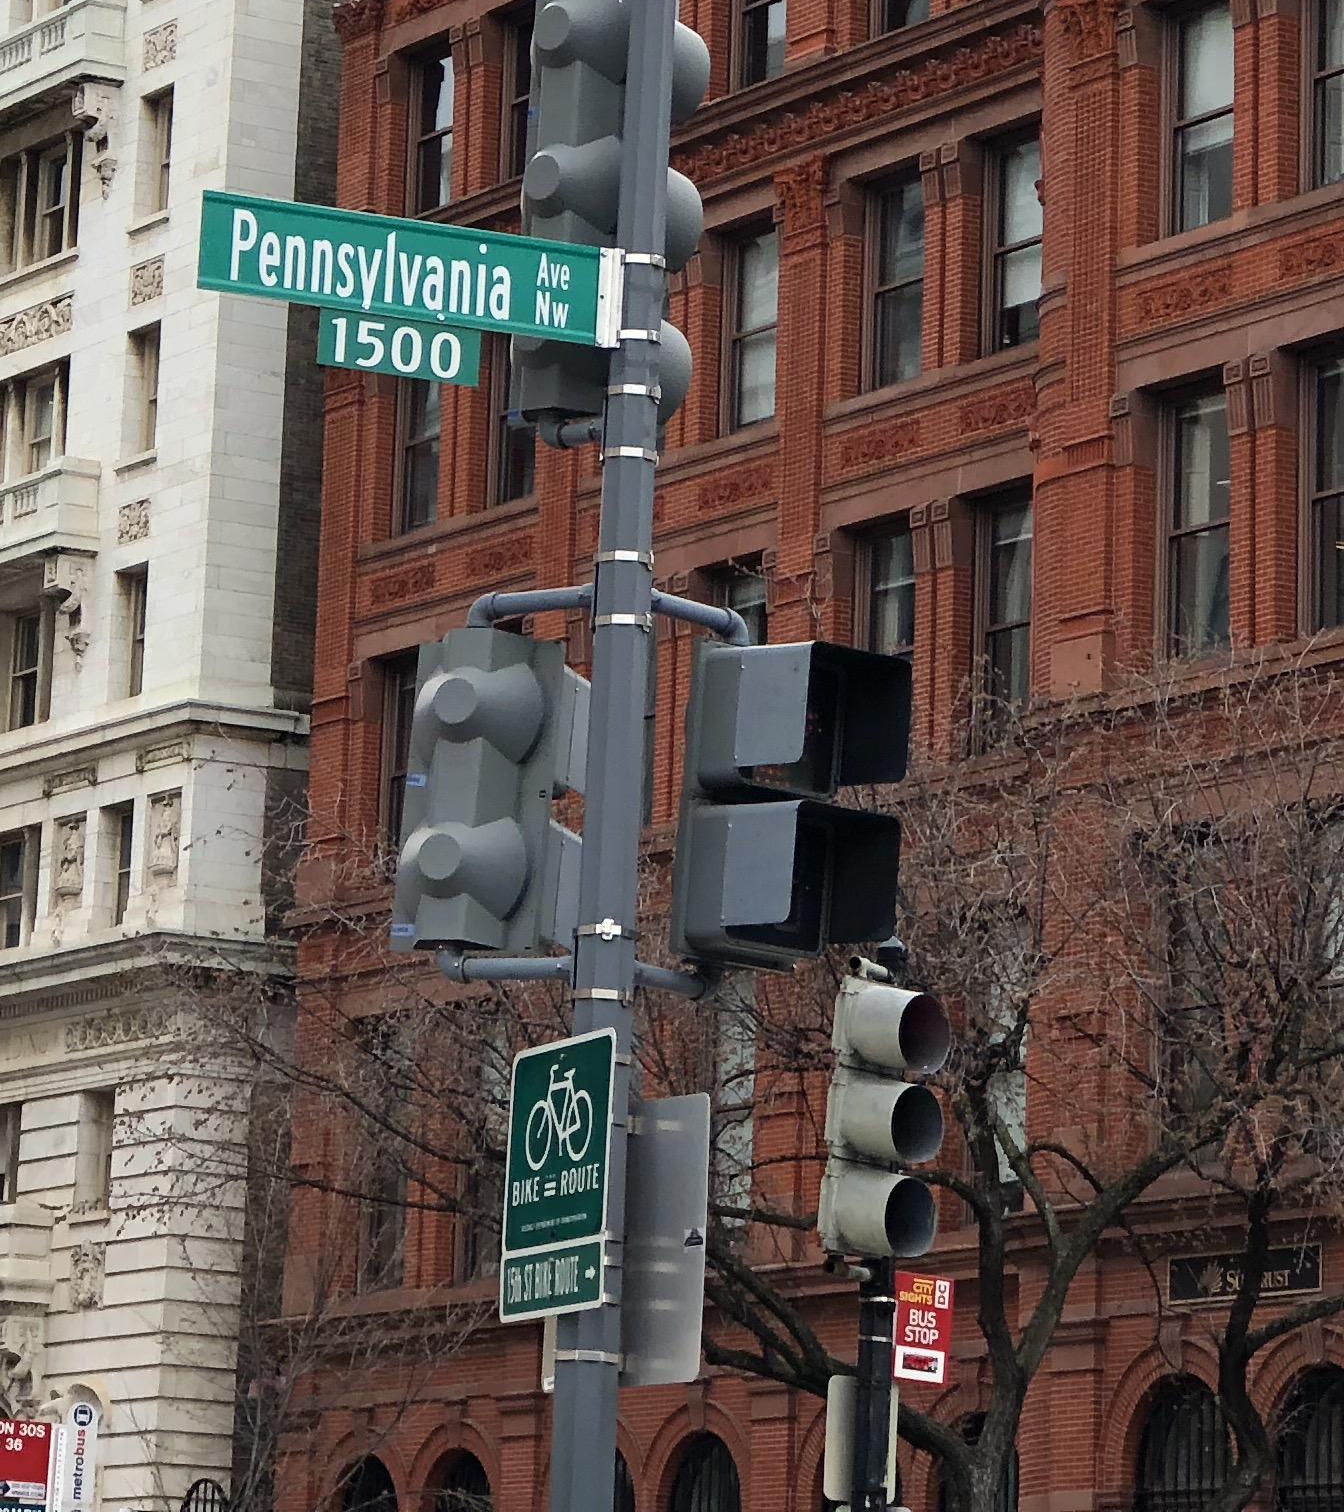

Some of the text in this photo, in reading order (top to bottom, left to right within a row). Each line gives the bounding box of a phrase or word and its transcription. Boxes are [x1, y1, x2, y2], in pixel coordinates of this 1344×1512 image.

[229, 208, 571, 321] Pennsylvania Ave
[330, 317, 462, 379] 1500
[512, 1163, 600, 1207] BIKE ROUTE
[899, 1291, 933, 1305] SIGHTS
[913, 1283, 933, 1294] CITY
[937, 1284, 946, 1305] DC
[909, 1308, 936, 1327] BUS
[904, 1325, 939, 1345] STOP
[19, 1423, 45, 1438] 30S
[5, 1438, 23, 1451] 36
[73, 1429, 86, 1500] metrobus
